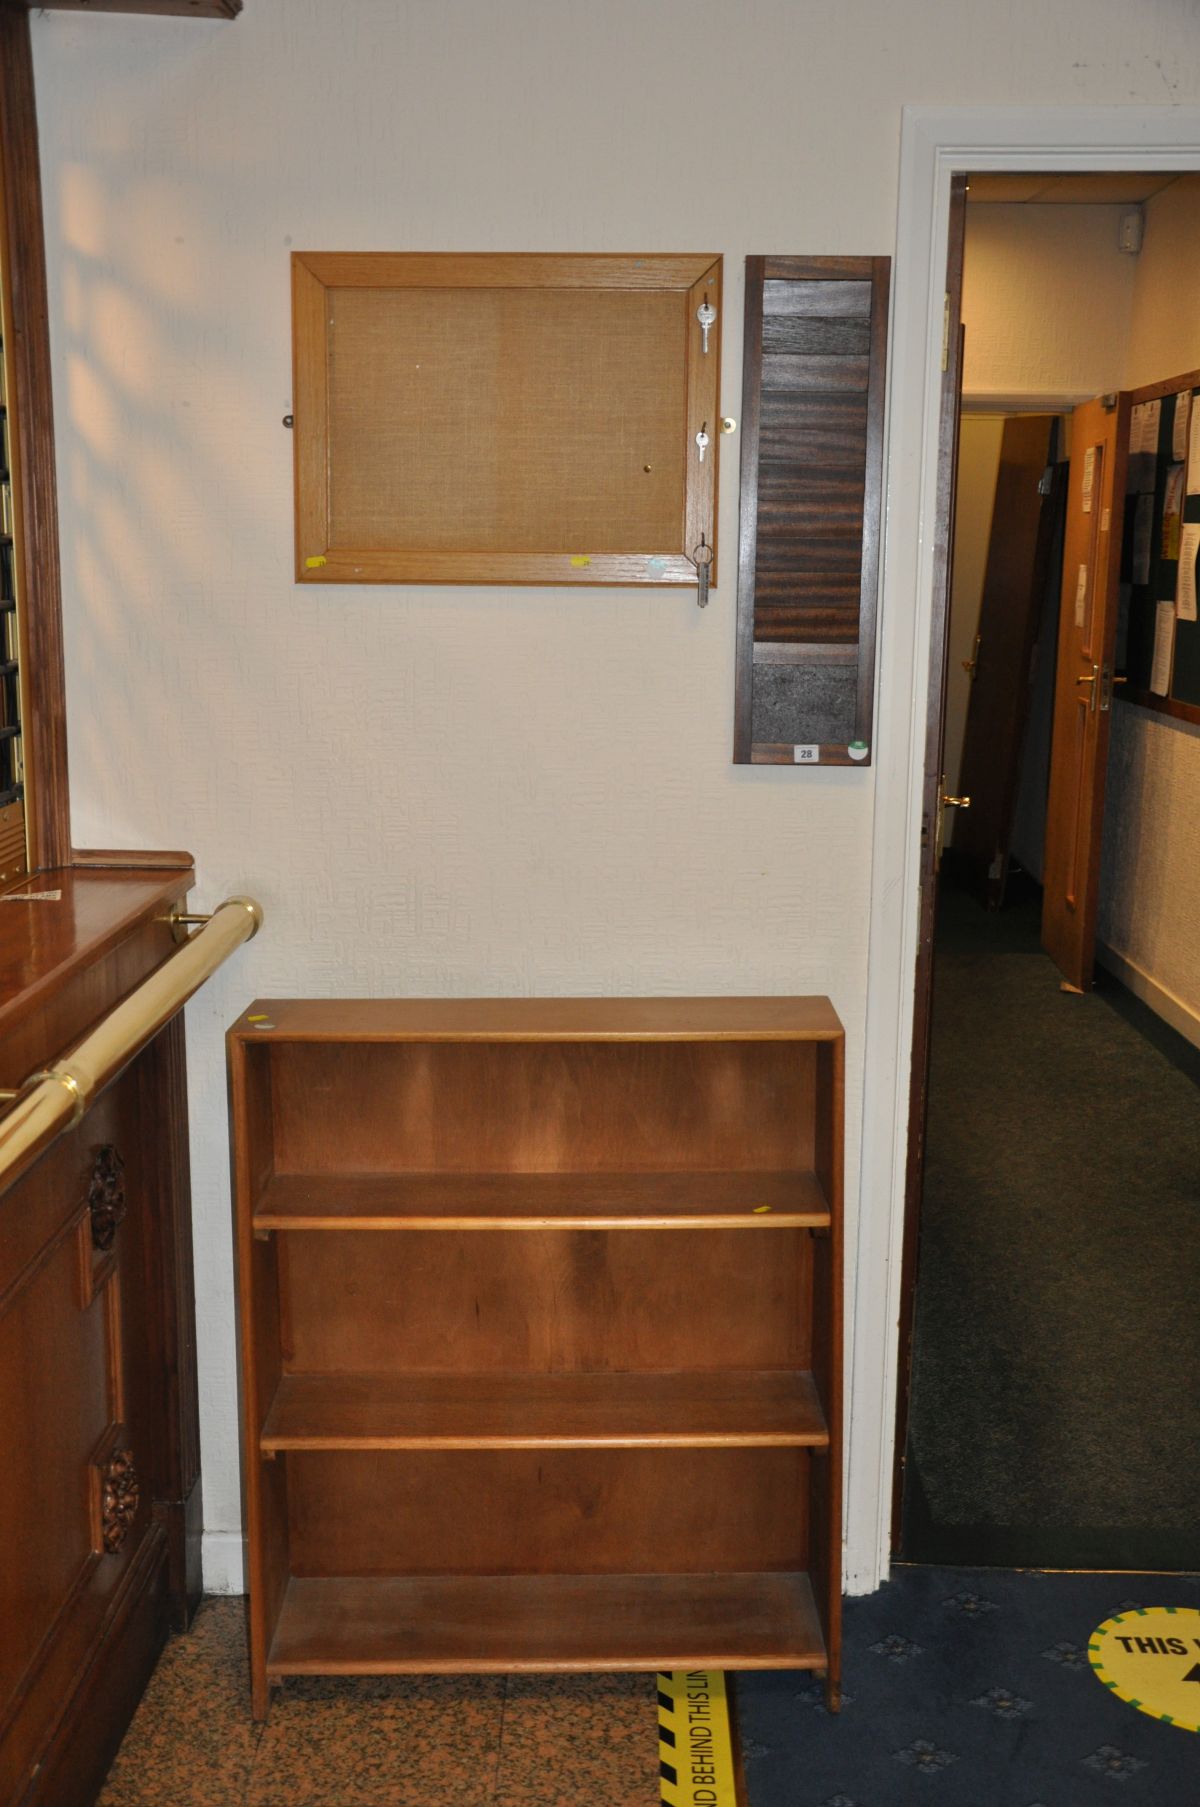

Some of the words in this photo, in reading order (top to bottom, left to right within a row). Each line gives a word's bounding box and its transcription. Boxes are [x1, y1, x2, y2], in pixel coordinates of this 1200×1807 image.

[800, 750, 813, 758] 28
[1114, 1637, 1188, 1655] THIS
[687, 1692, 710, 1723] THIS
[690, 1726, 715, 1785] BEHIND
